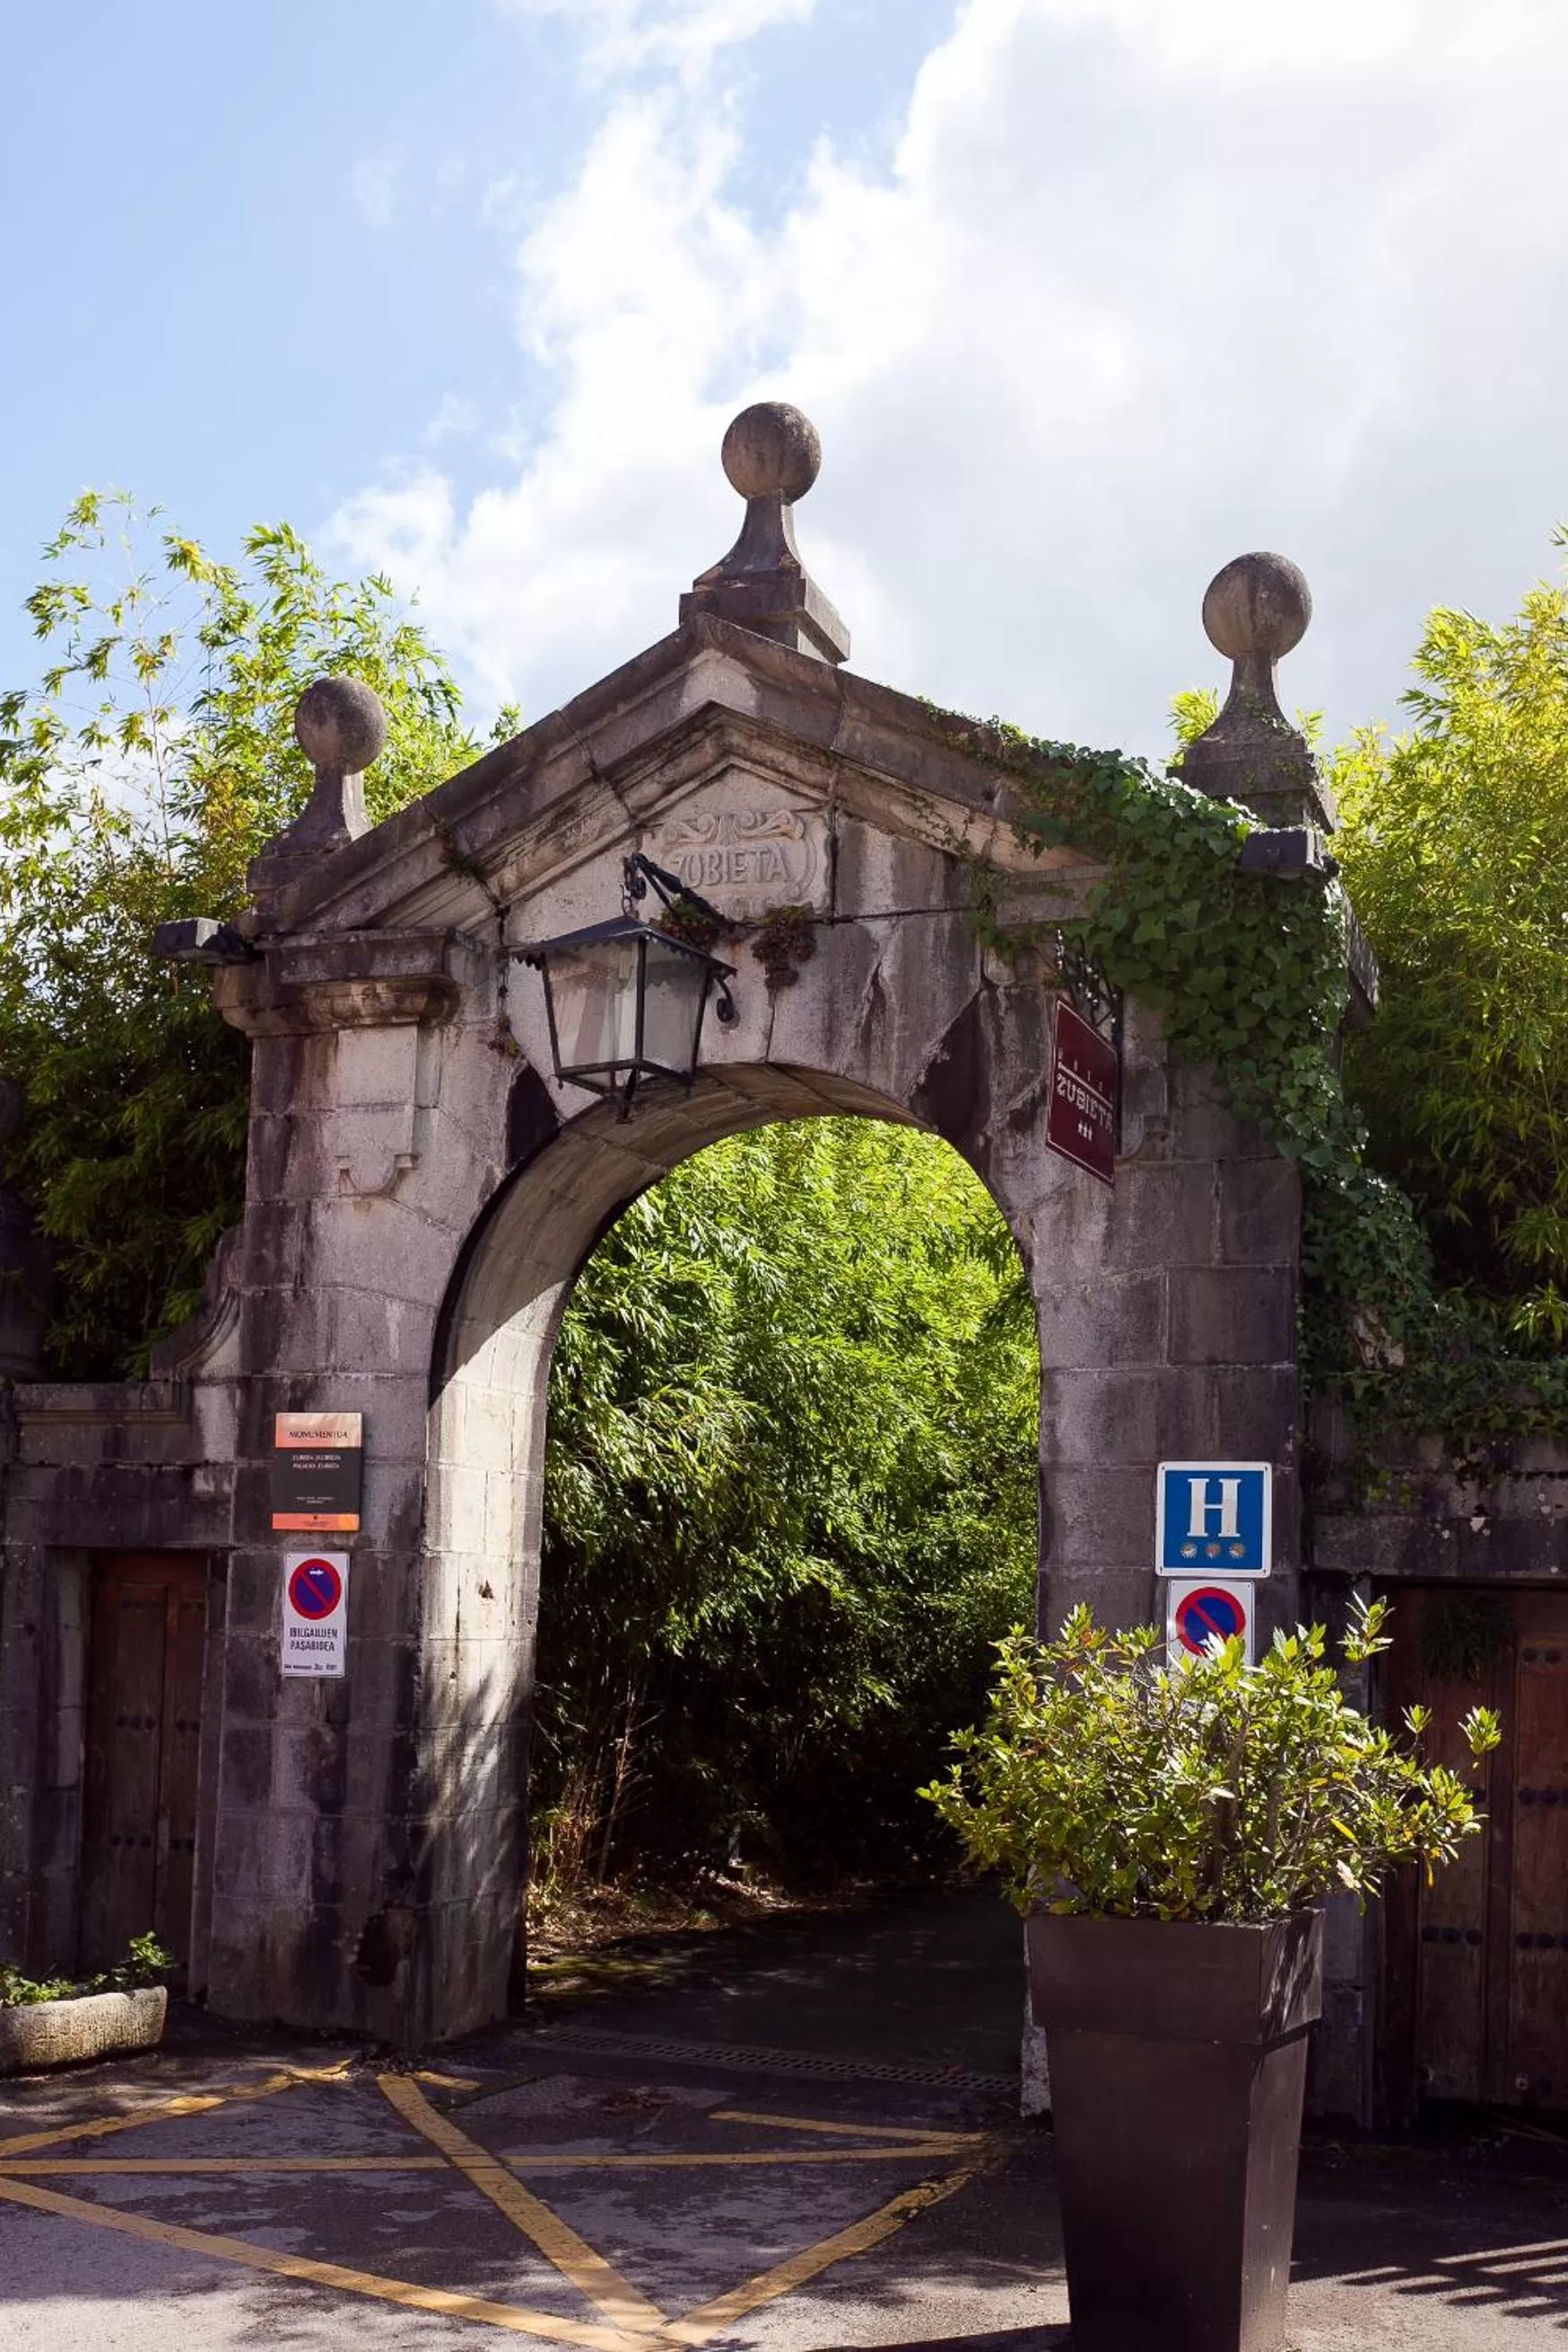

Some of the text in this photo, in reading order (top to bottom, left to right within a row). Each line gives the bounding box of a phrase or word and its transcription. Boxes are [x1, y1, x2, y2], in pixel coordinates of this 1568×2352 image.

[1057, 1073, 1113, 1135] ZUBIETA
[289, 1431, 348, 1439] MONUMENTUA
[1187, 1477, 1241, 1538] H
[291, 1641, 335, 1651] PASABIDEA
